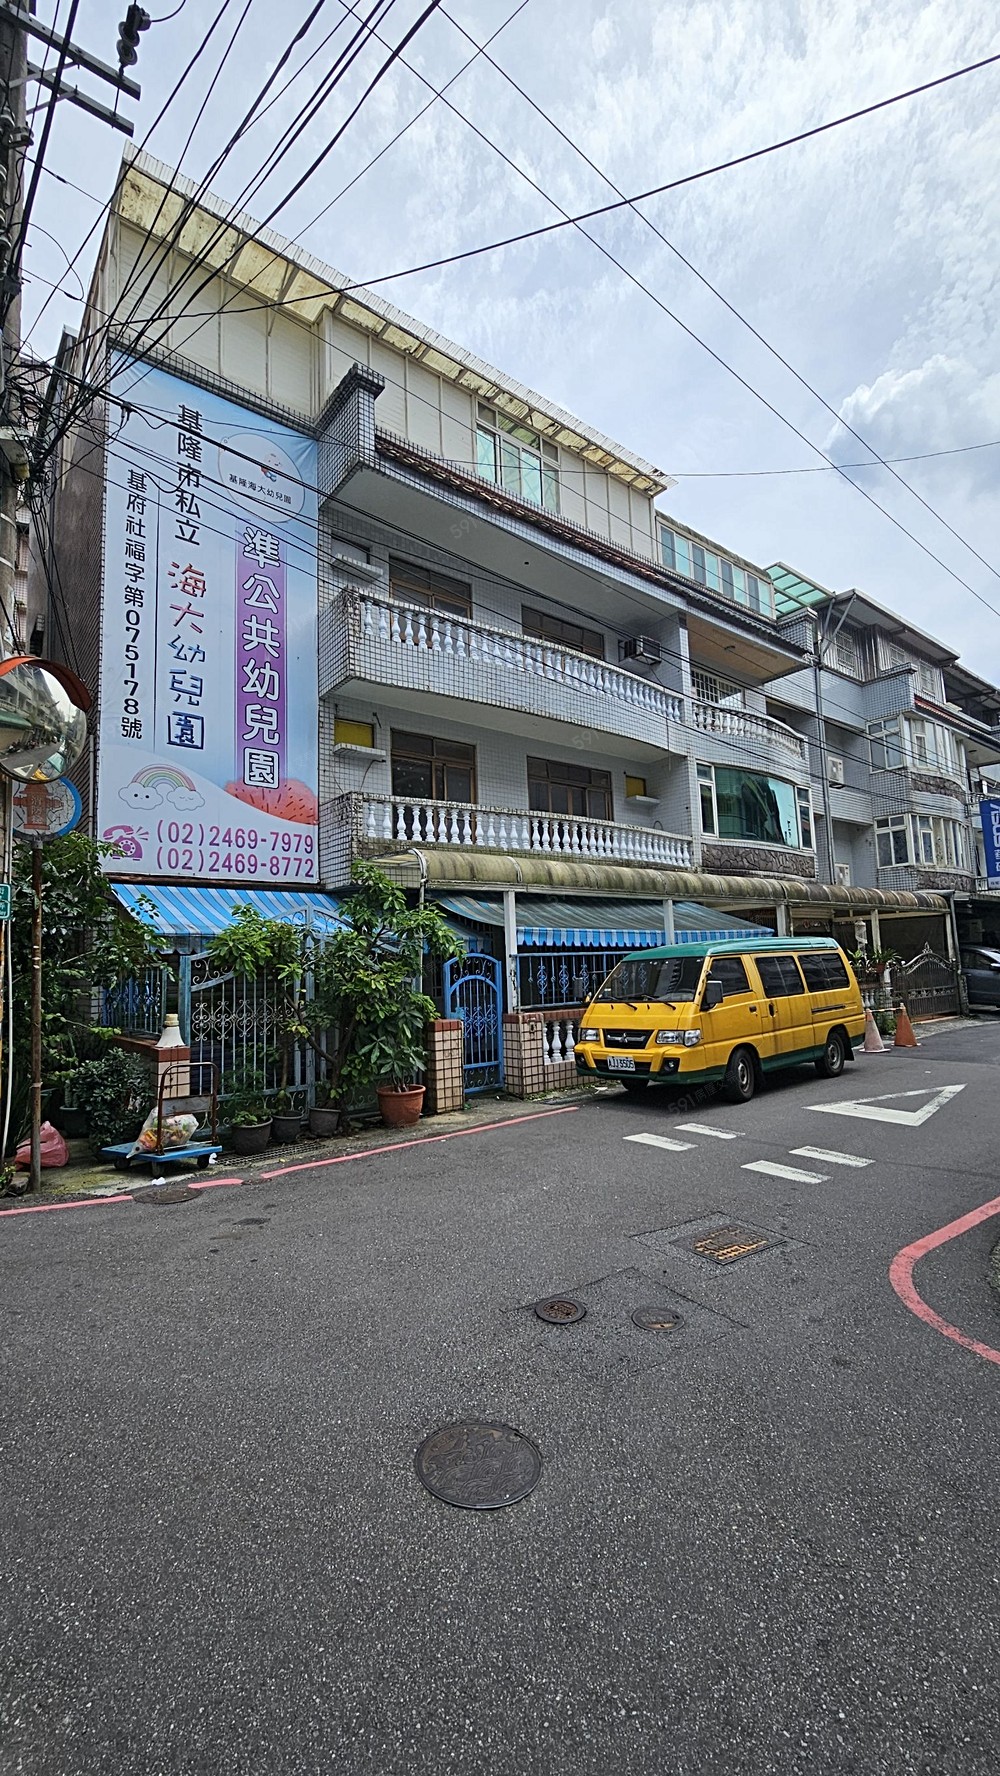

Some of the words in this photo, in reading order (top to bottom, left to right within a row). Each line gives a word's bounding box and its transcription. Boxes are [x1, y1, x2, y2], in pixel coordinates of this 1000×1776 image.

[174, 404, 203, 546] 基隆市私立
[228, 473, 293, 505] 基隆海大幼兒園
[120, 468, 148, 740] 基府社福字第075178號
[167, 561, 207, 750] 海大幼兒園
[241, 525, 281, 790] 準公共幼兒園
[156, 819, 314, 855] (02)2469-7979
[156, 846, 314, 879] (02)2469-8772
